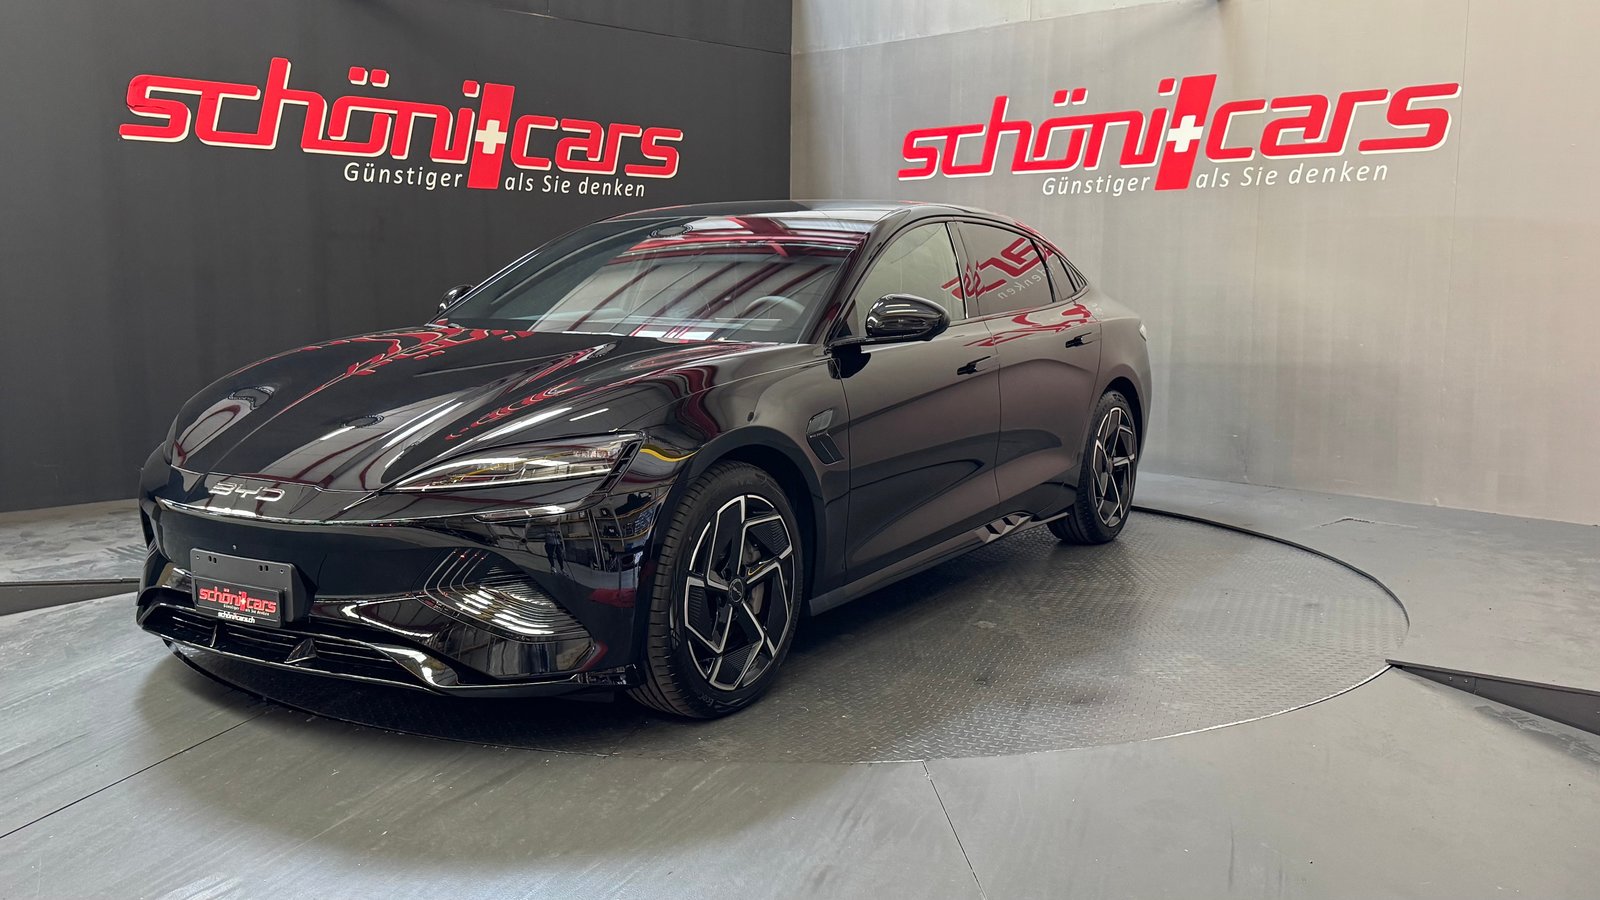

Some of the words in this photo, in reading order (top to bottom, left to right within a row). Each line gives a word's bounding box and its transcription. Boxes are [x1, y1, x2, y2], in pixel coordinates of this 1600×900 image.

[344, 162, 463, 190] Günstiger
[505, 172, 534, 192] als
[541, 175, 571, 194] Sie
[578, 176, 645, 197] denken
[1042, 174, 1150, 197] Günstiger
[1196, 168, 1231, 189] als
[1240, 166, 1278, 187] Sie
[1288, 160, 1388, 185] denken
[208, 482, 285, 502] BYD
